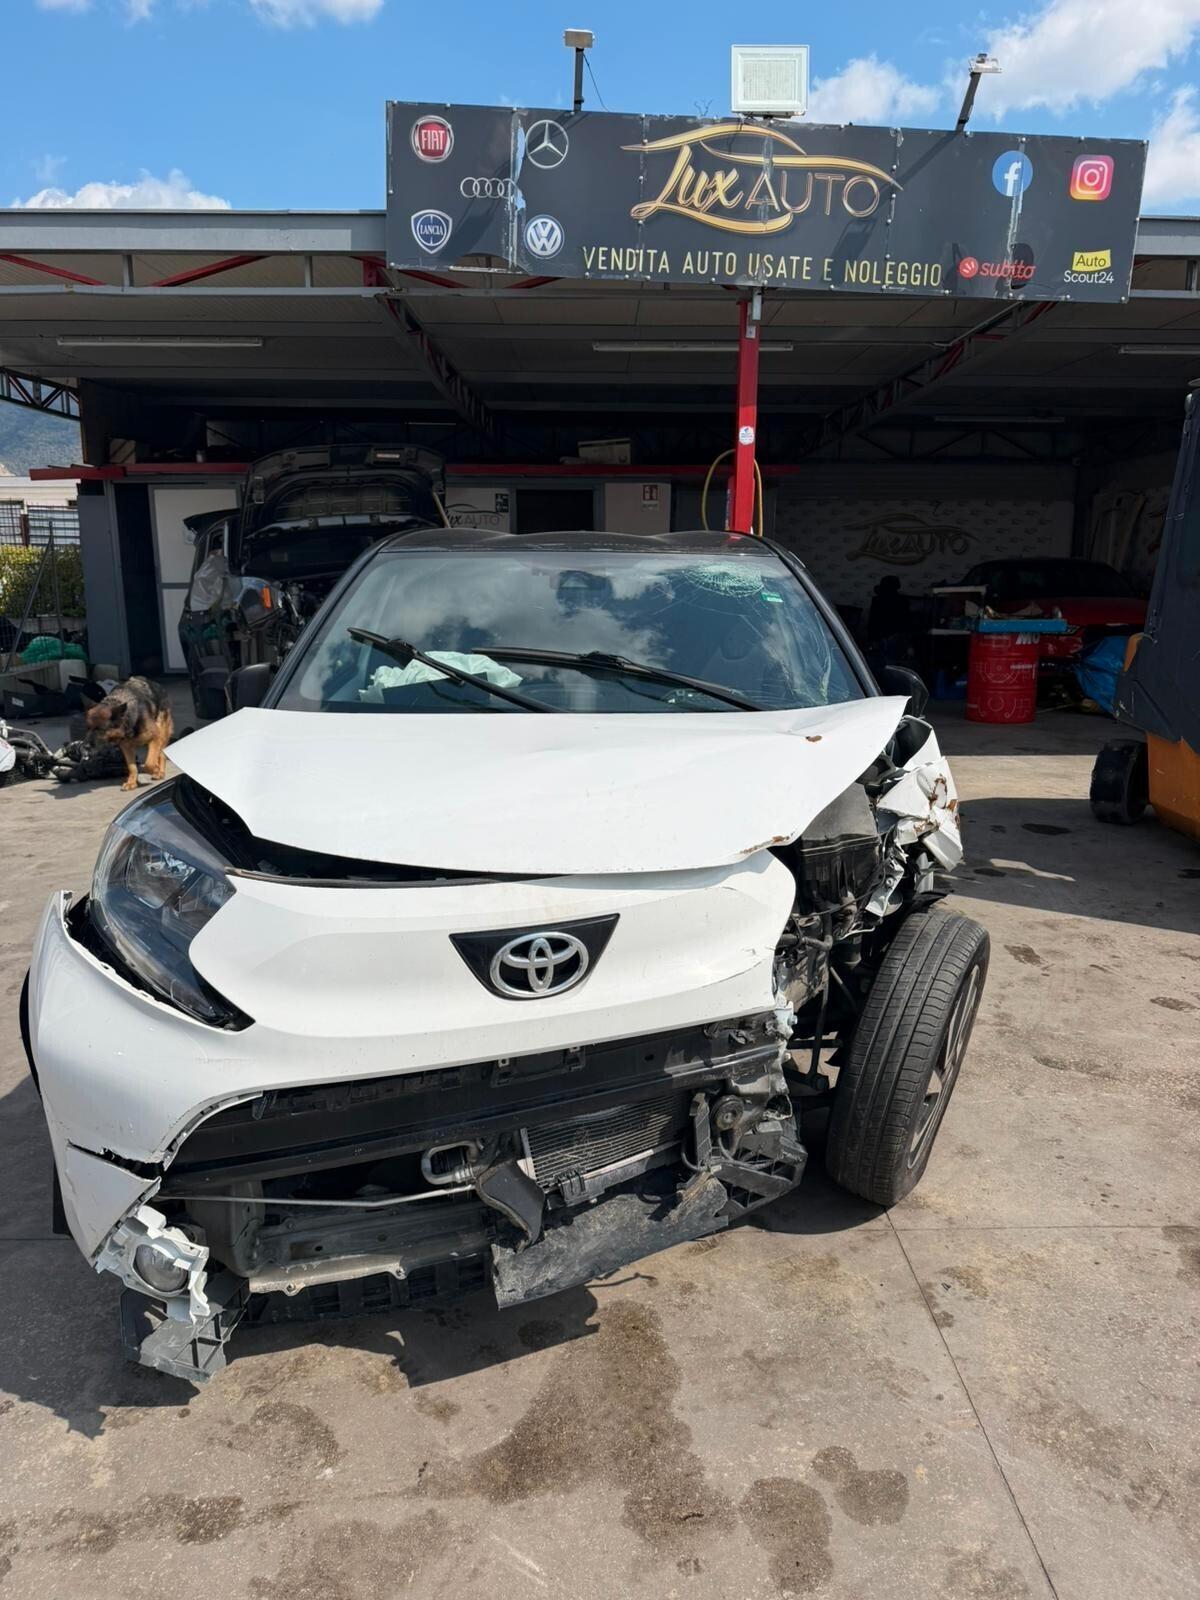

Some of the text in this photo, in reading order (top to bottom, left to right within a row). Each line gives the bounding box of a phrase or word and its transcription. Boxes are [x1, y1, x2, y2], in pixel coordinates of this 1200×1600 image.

[421, 129, 446, 150] FIAT
[630, 144, 880, 222] Lux AUTO
[419, 223, 444, 237] LANCIA
[582, 245, 943, 287] VENDITA AUTO USATE E NOLEGGIO
[979, 257, 1037, 281] subito
[1075, 254, 1107, 268] Auto
[1063, 270, 1115, 284] Scout24
[464, 514, 500, 526] AUTO
